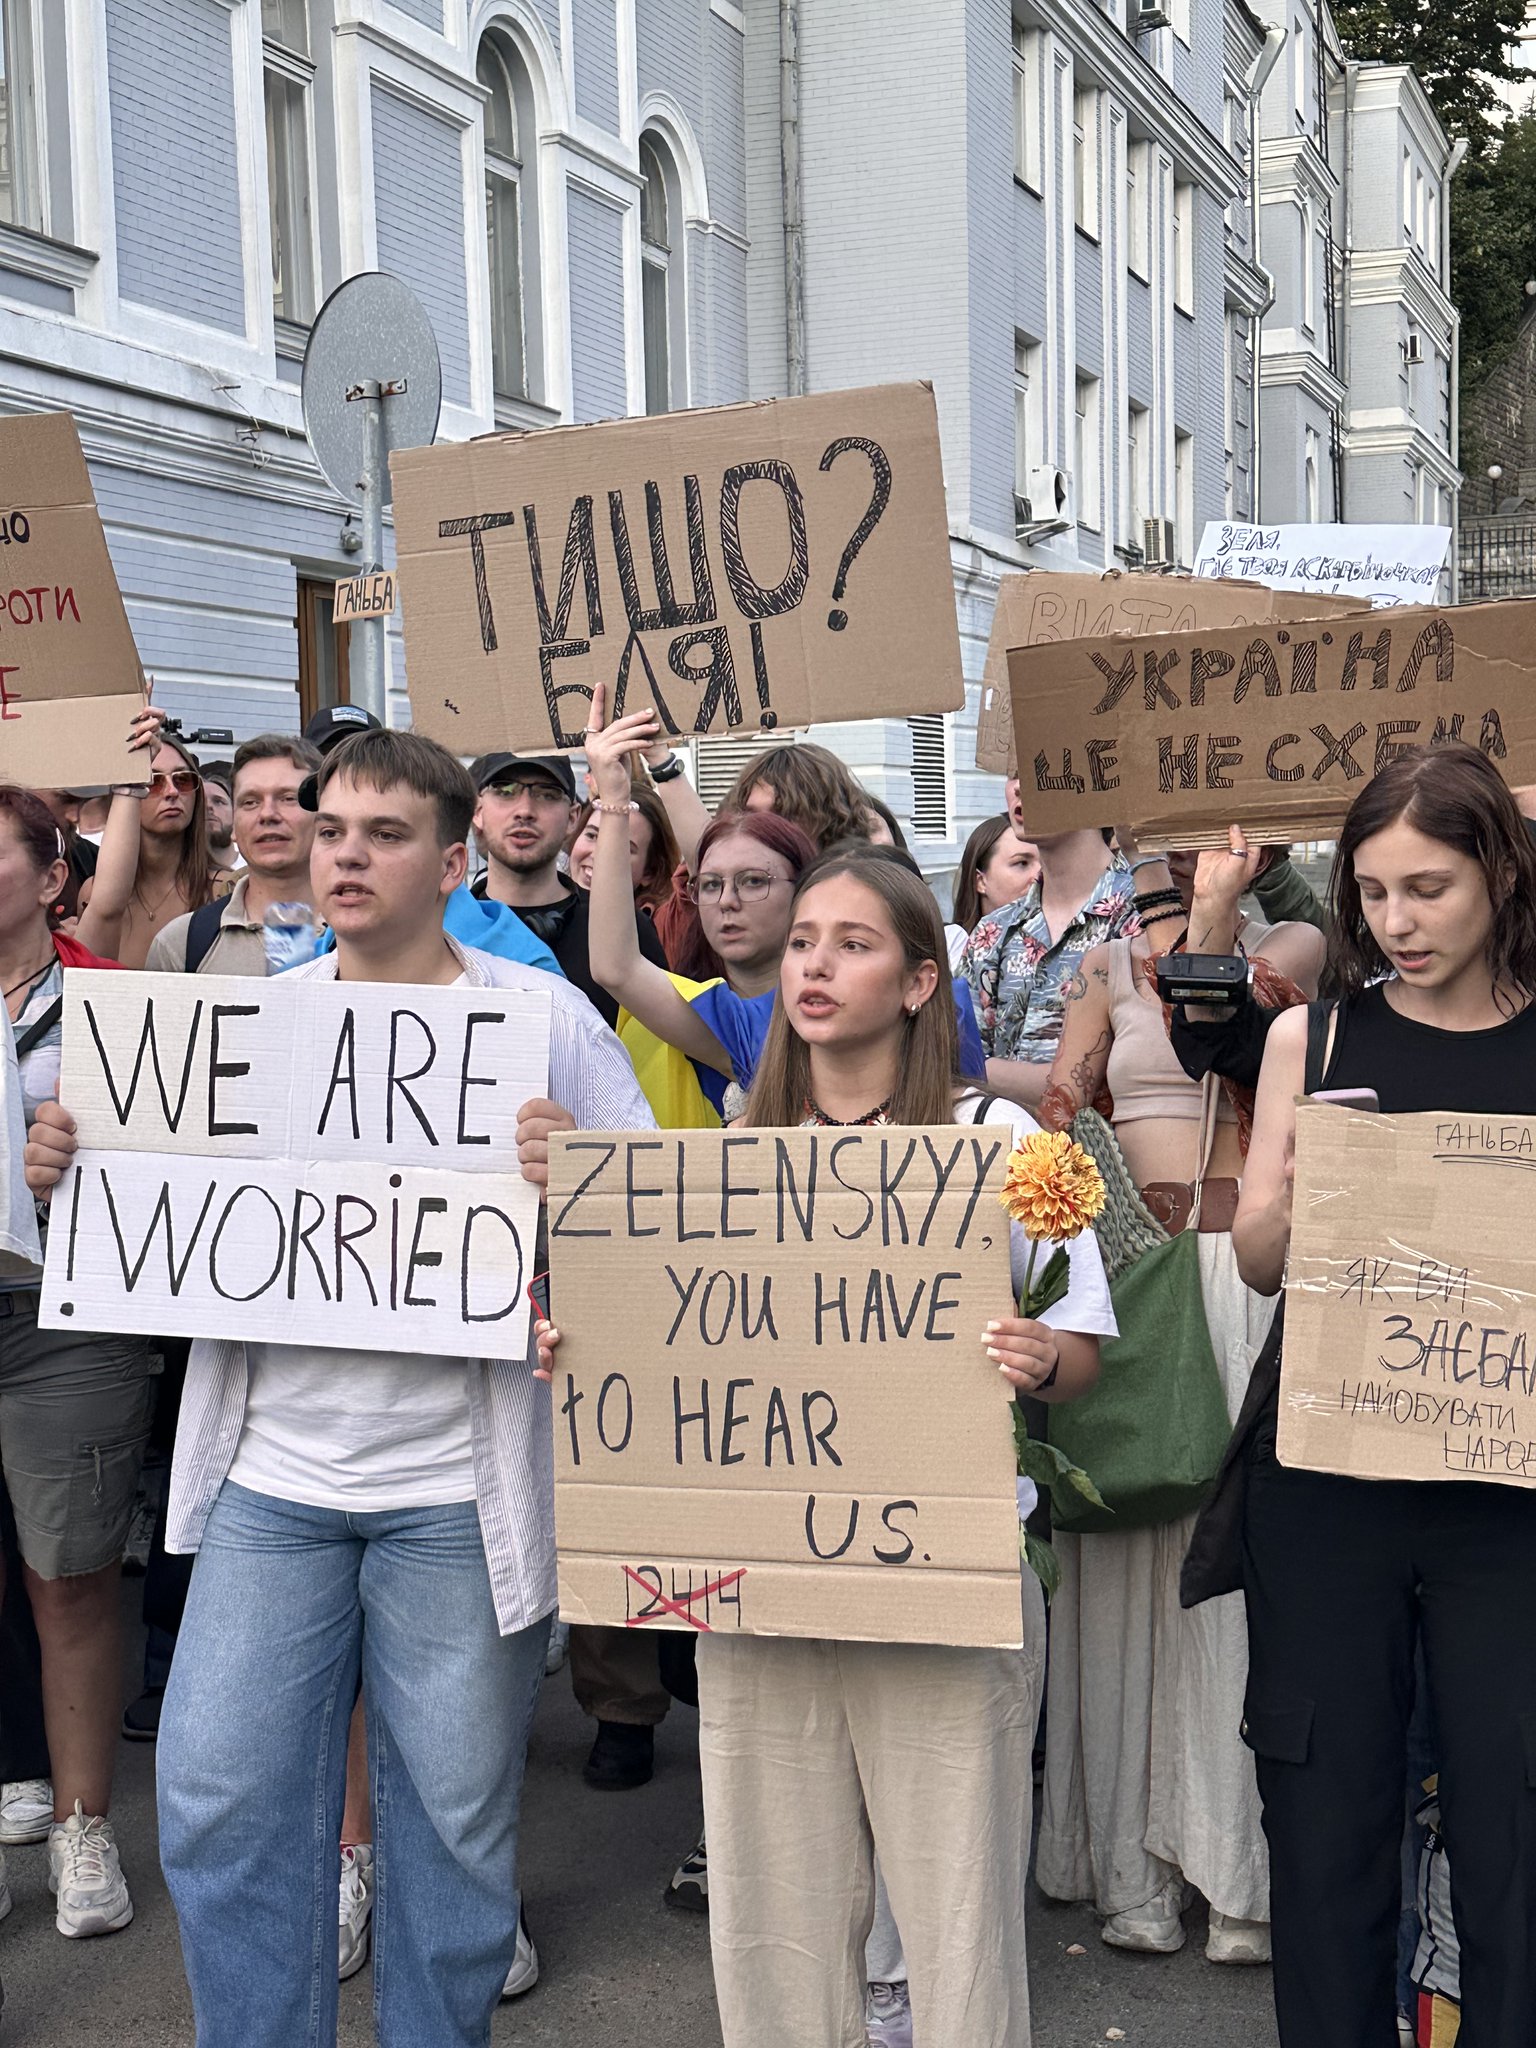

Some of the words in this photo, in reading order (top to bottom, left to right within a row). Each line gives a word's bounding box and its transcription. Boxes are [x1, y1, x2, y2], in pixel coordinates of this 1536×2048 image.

[336, 575, 394, 617] ГАНЬБА
[1238, 556, 1289, 578] ТВОЯ
[1084, 617, 1456, 716] УКРАЇНА
[1033, 739, 1120, 794] ЦЕ
[1157, 733, 1243, 793] НЕ
[83, 998, 261, 1137] WE
[316, 1007, 507, 1147] ARE
[1435, 1122, 1533, 1153] ГАНЬБА
[551, 1135, 1002, 1251] ZELENSKYY,
[664, 1264, 779, 1347] YOU
[813, 1268, 963, 1346] HAVE
[1340, 1256, 1394, 1307] ЯК
[1415, 1259, 1469, 1314] ВИ
[673, 1375, 843, 1468] HEAR
[1340, 1378, 1516, 1435] НАЙОБУВАТИ
[804, 1494, 933, 1564] US.
